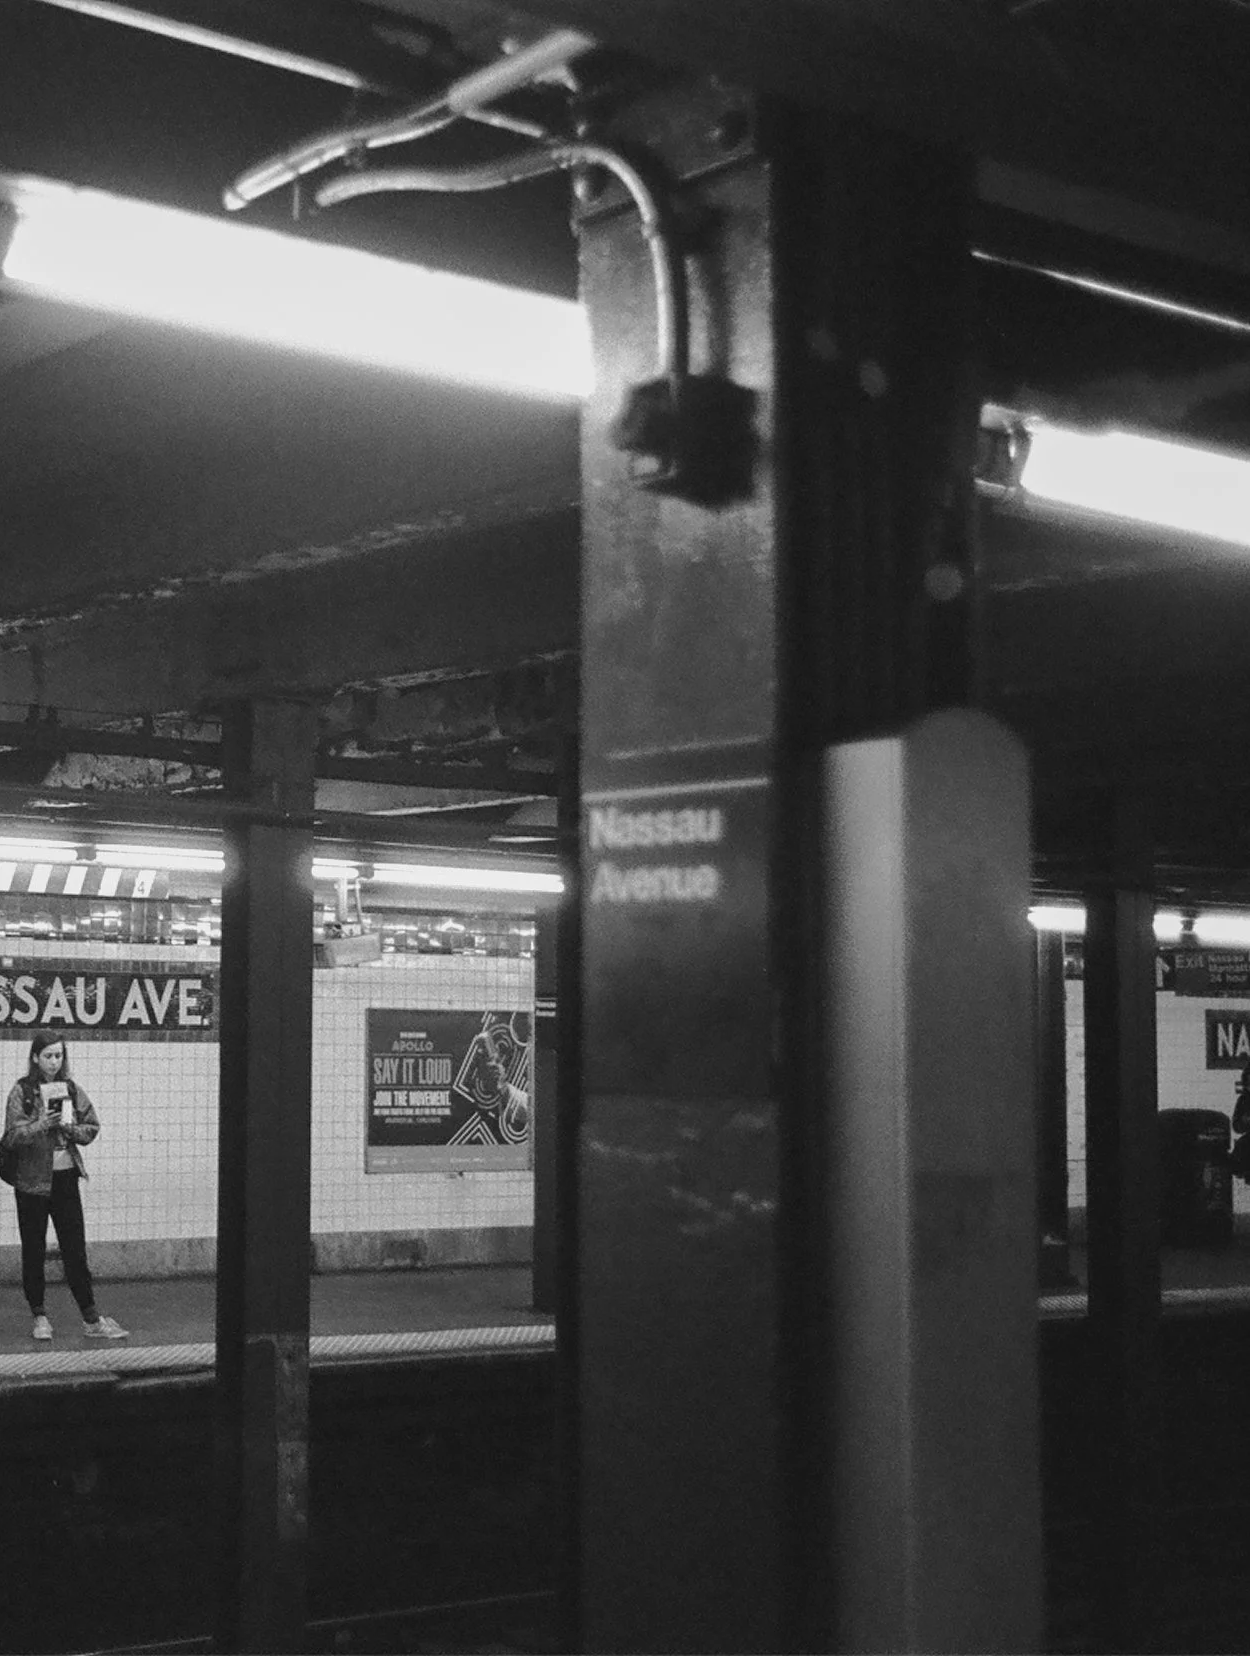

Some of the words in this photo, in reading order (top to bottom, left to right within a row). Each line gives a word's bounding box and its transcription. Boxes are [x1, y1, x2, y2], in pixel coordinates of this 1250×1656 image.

[589, 807, 721, 848] Nassau
[136, 881, 145, 894] 4
[590, 862, 719, 903] Avenue
[1175, 955, 1204, 968] Exit
[391, 1041, 434, 1051] APOLLO
[373, 1058, 400, 1085] SAY
[402, 1058, 415, 1085] IT
[418, 1058, 452, 1085] LOUD
[393, 1091, 408, 1106] THE
